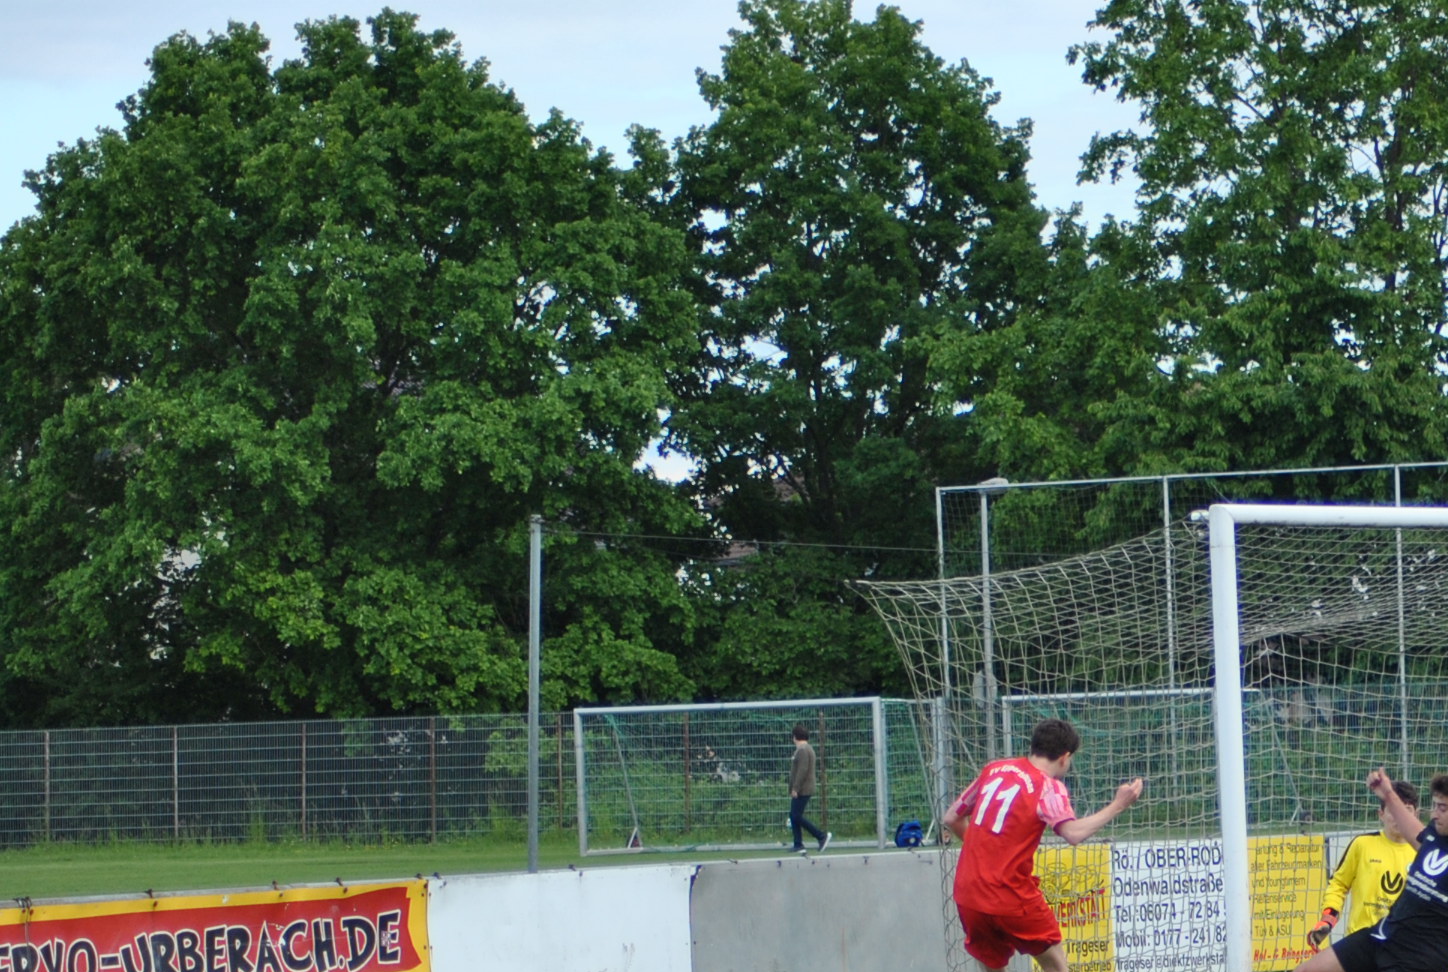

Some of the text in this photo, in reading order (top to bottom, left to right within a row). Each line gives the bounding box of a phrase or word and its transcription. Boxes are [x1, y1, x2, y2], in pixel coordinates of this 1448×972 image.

[974, 777, 1020, 834] 11
[1145, 846, 1224, 869] OBER-ROD
[1113, 873, 1223, 897] Odenwaldstraße
[1065, 939, 1109, 957] Trageser
[1154, 928, 1182, 946] 0177
